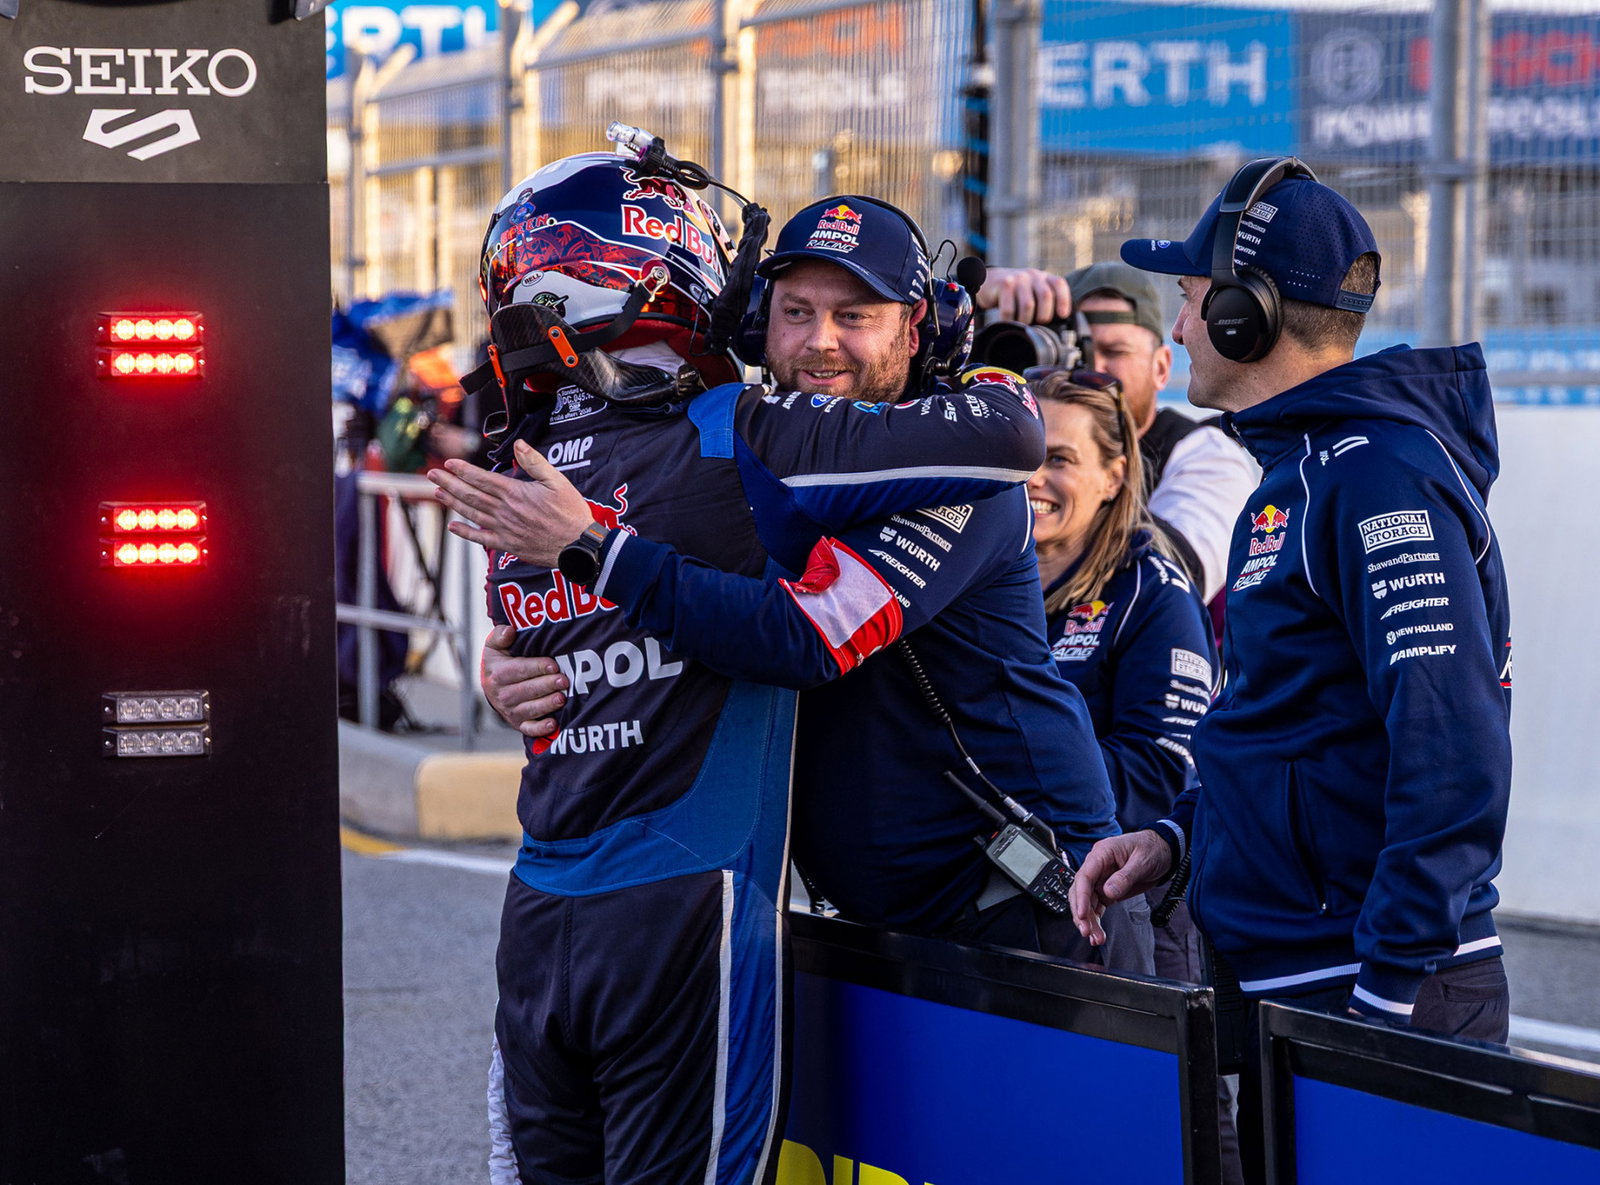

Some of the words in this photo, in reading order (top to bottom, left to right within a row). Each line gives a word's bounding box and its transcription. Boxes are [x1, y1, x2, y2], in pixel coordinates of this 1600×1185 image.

[23, 46, 257, 97] SEIKO
[1037, 40, 1267, 107] ERTH
[620, 203, 683, 248] Red
[806, 239, 855, 252] RACING
[809, 230, 860, 246] AMPOL
[547, 435, 594, 465] OMP
[1362, 514, 1426, 534] NATIONAL
[1368, 526, 1426, 545] STORAGE
[895, 535, 941, 572] WÜRTH
[1240, 554, 1278, 575] AMPOL
[1367, 552, 1440, 573] ShawandPartners
[868, 548, 927, 589] FREIGHTER
[1389, 572, 1446, 591] WÜRTH
[498, 568, 571, 632] Red
[1380, 597, 1450, 620] FREIGHTER
[1396, 626, 1413, 638] NEW
[1415, 622, 1454, 634] HOLLAND
[1397, 644, 1457, 661] AMPLIFY
[550, 720, 644, 755] WÜRTH
